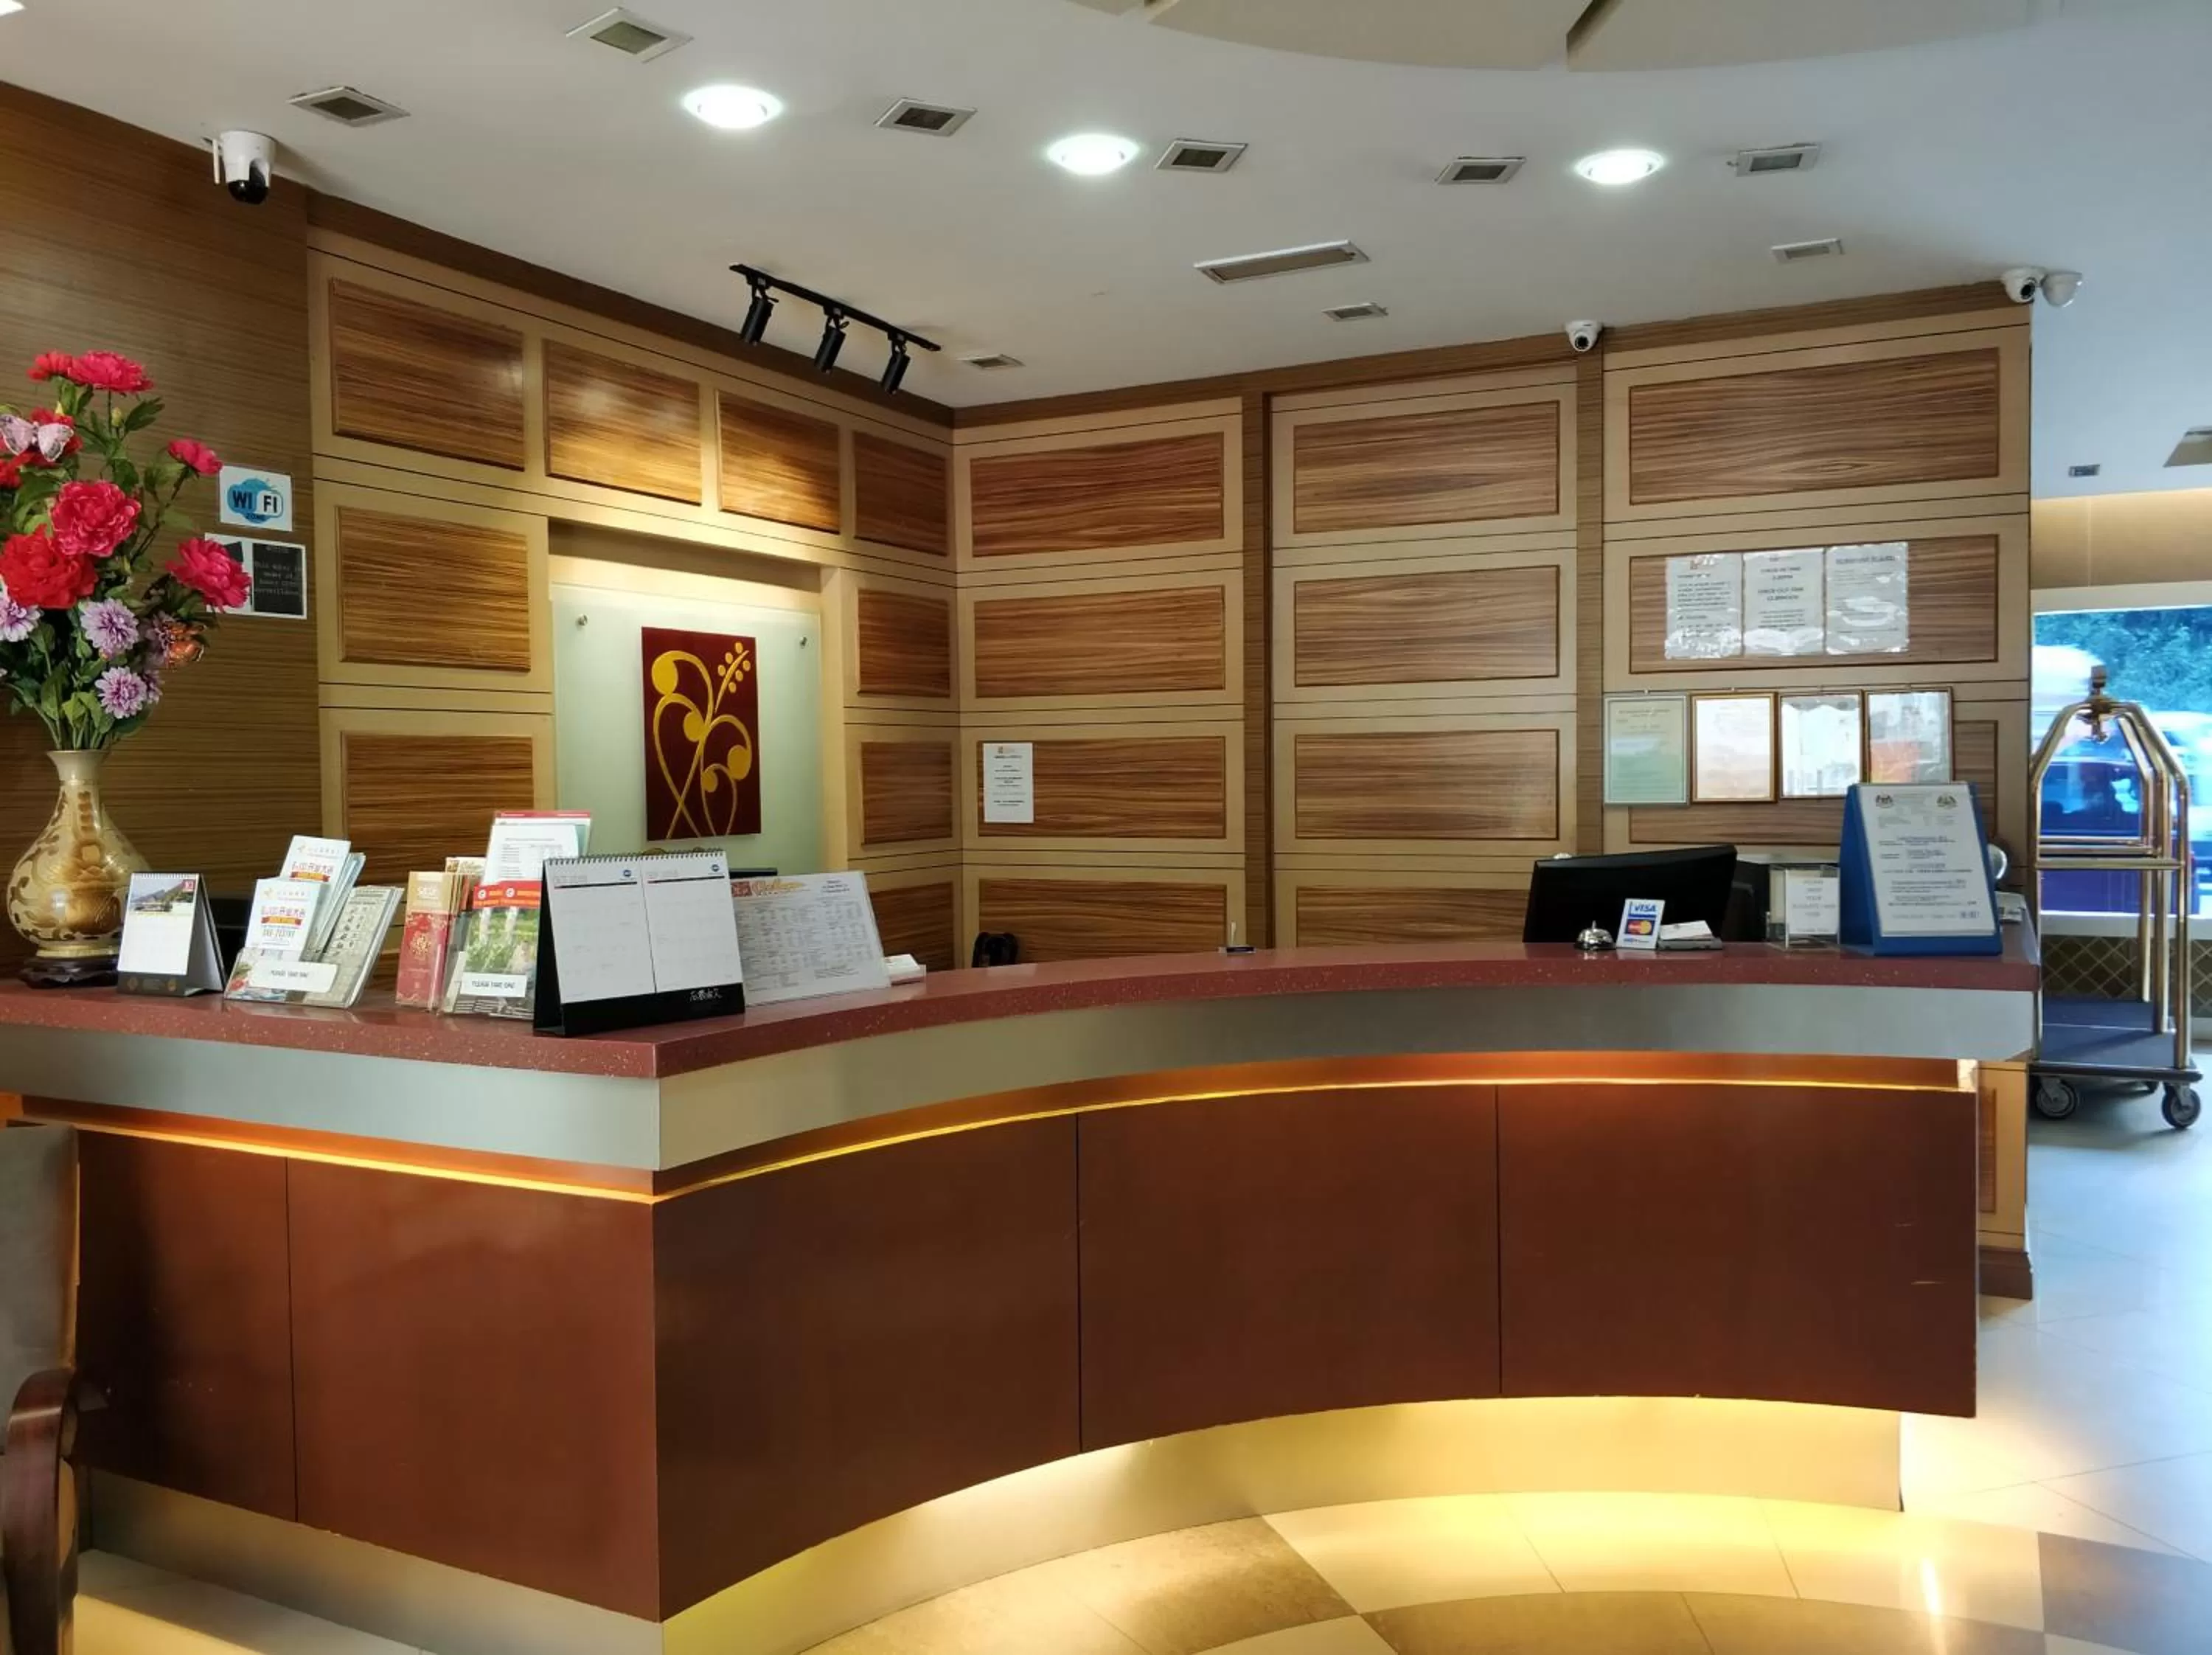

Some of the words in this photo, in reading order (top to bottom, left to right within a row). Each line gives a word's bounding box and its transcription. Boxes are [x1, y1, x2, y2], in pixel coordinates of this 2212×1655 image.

[232, 490, 252, 509] WI
[263, 495, 277, 513] FI
[1634, 903, 1656, 912] VISA
